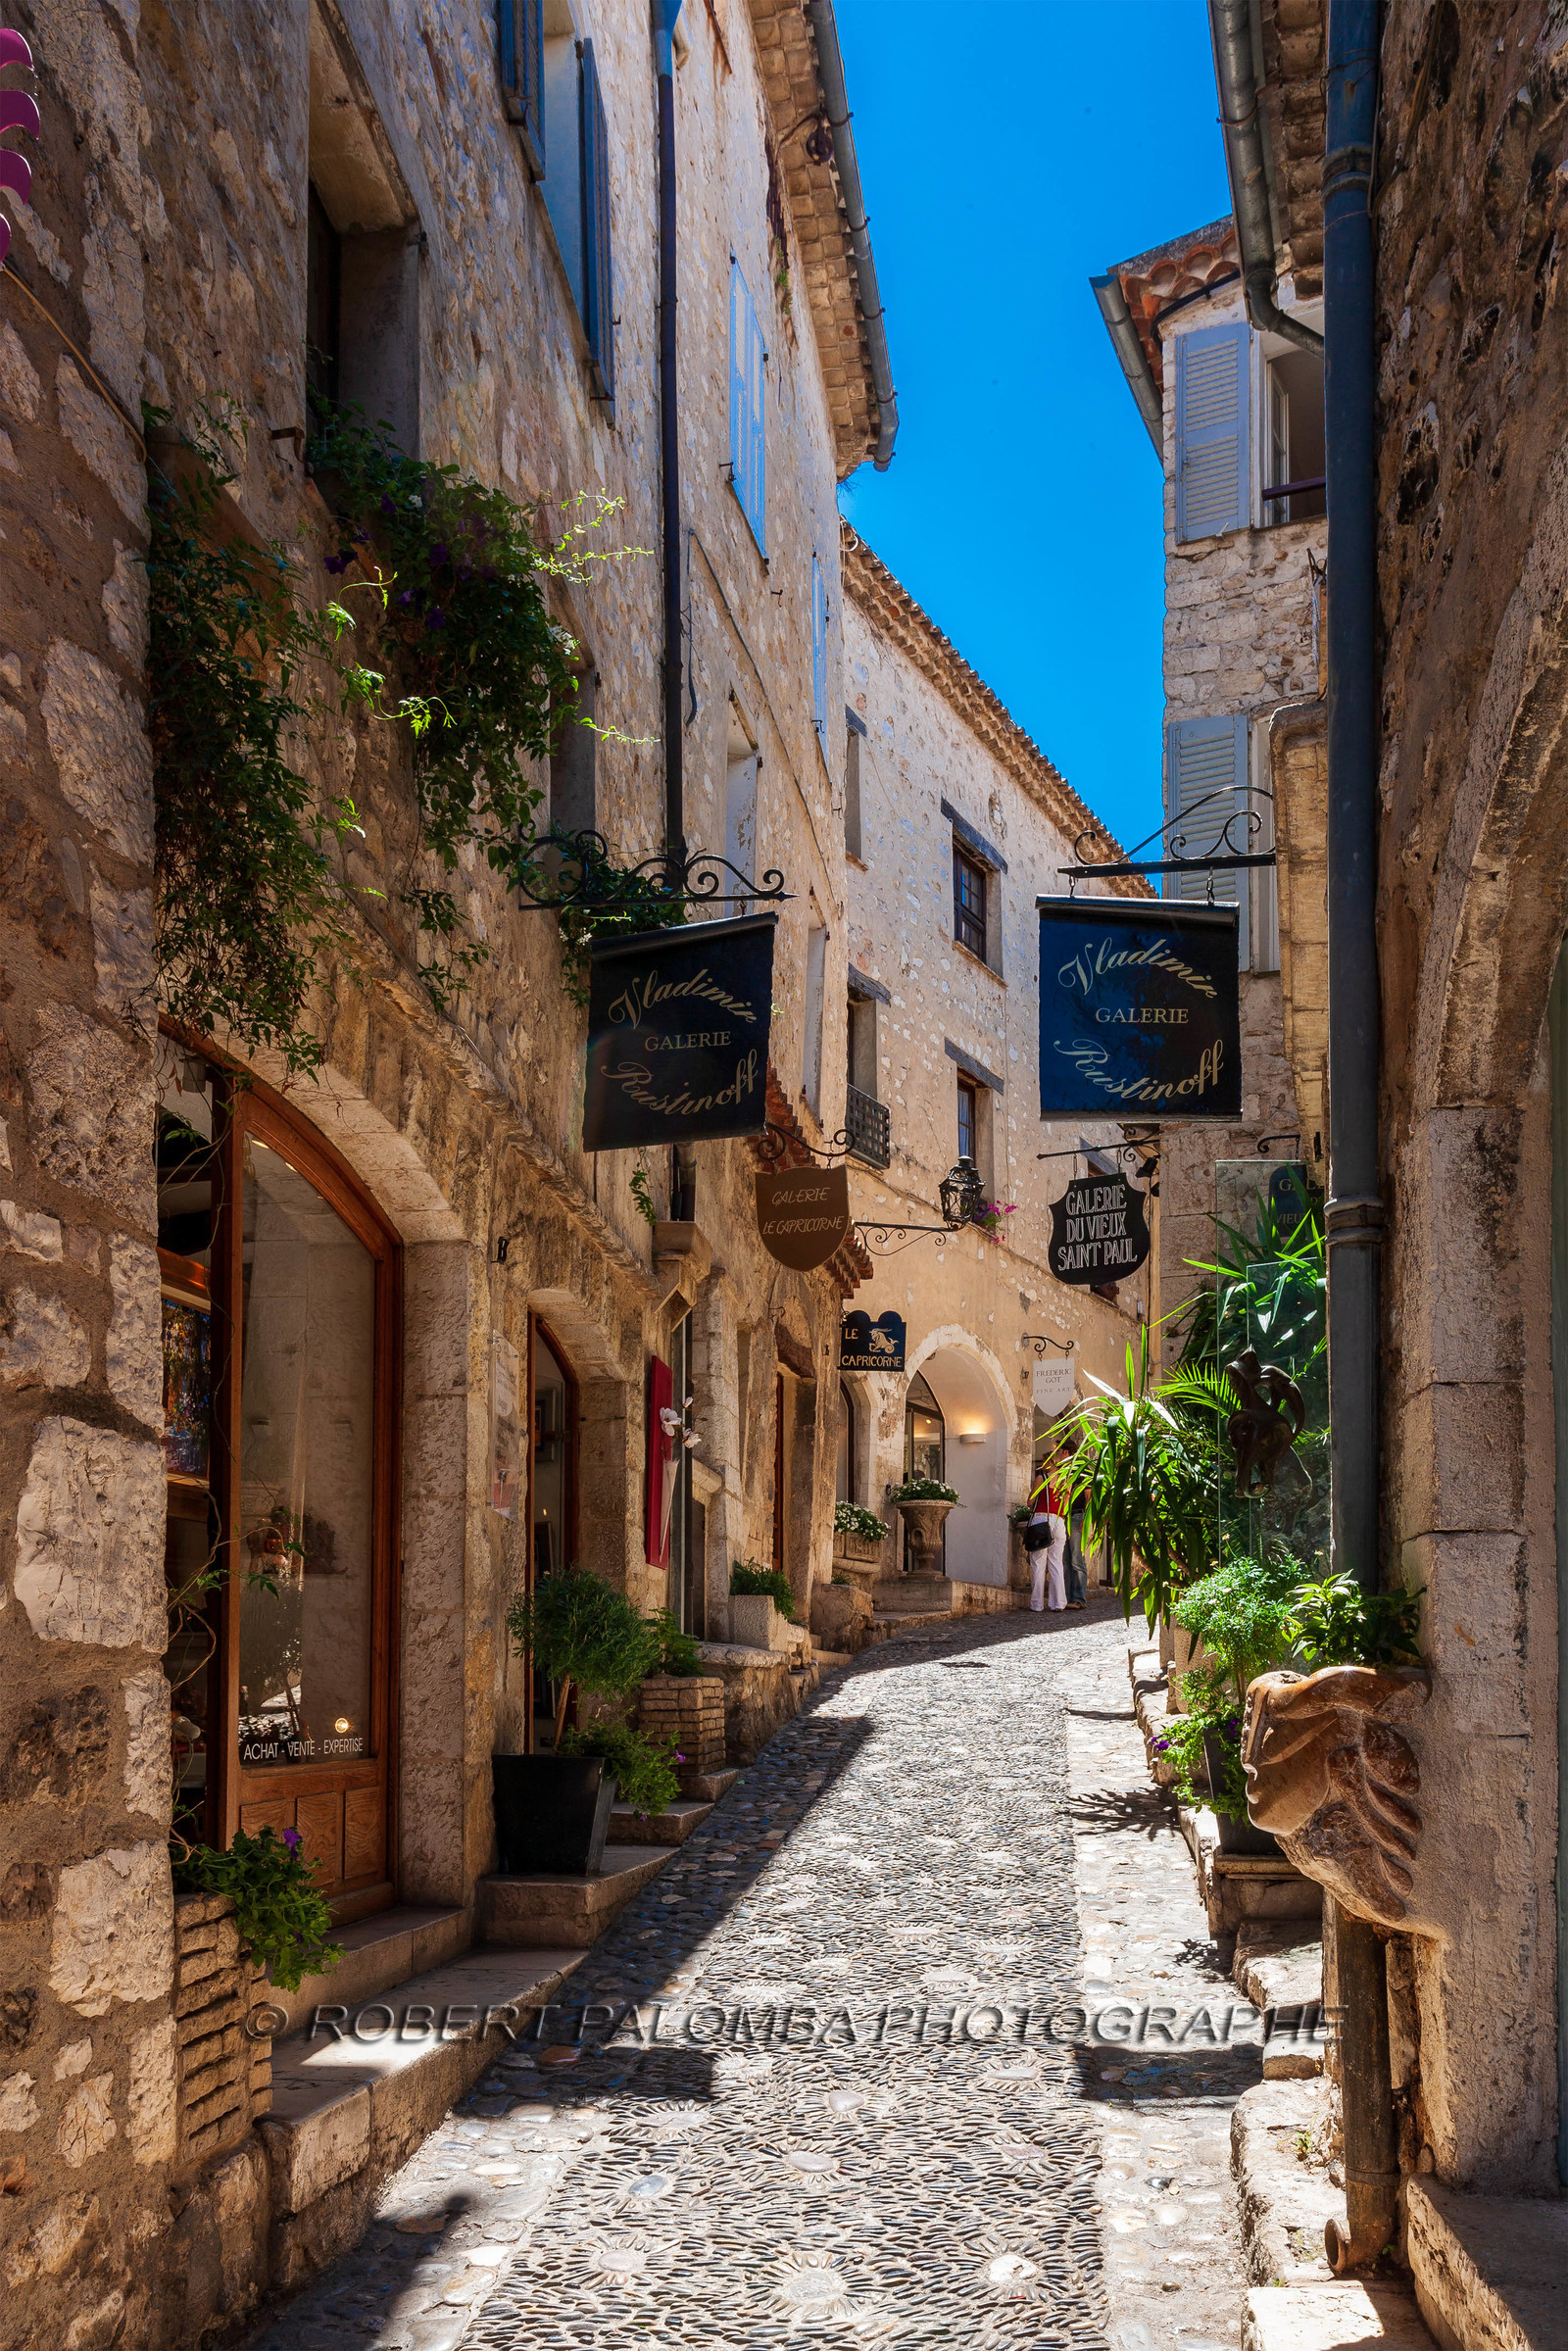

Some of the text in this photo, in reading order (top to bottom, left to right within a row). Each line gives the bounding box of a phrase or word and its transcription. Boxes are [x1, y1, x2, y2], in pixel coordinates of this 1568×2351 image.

[1057, 936, 1219, 999] Vladimir
[608, 968, 758, 1029] Vladimir
[1095, 1007, 1190, 1024] GALERIE
[645, 1031, 732, 1052] GALERIE
[771, 1187, 831, 1206] GALERIE
[1065, 1184, 1128, 1215] GALERIE
[762, 1215, 845, 1235] LE CAPRICORNE
[1066, 1211, 1127, 1244] DU VIEUX
[1057, 1238, 1138, 1272] SAINT PAUL
[845, 1328, 859, 1340] LE
[841, 1354, 904, 1368] CAPRICORNE
[1036, 1368, 1072, 1377] FREDERIC
[243, 1741, 279, 1760] ACHAT
[288, 1740, 316, 1756] VENTE
[323, 1737, 364, 1754] EXPERTISE
